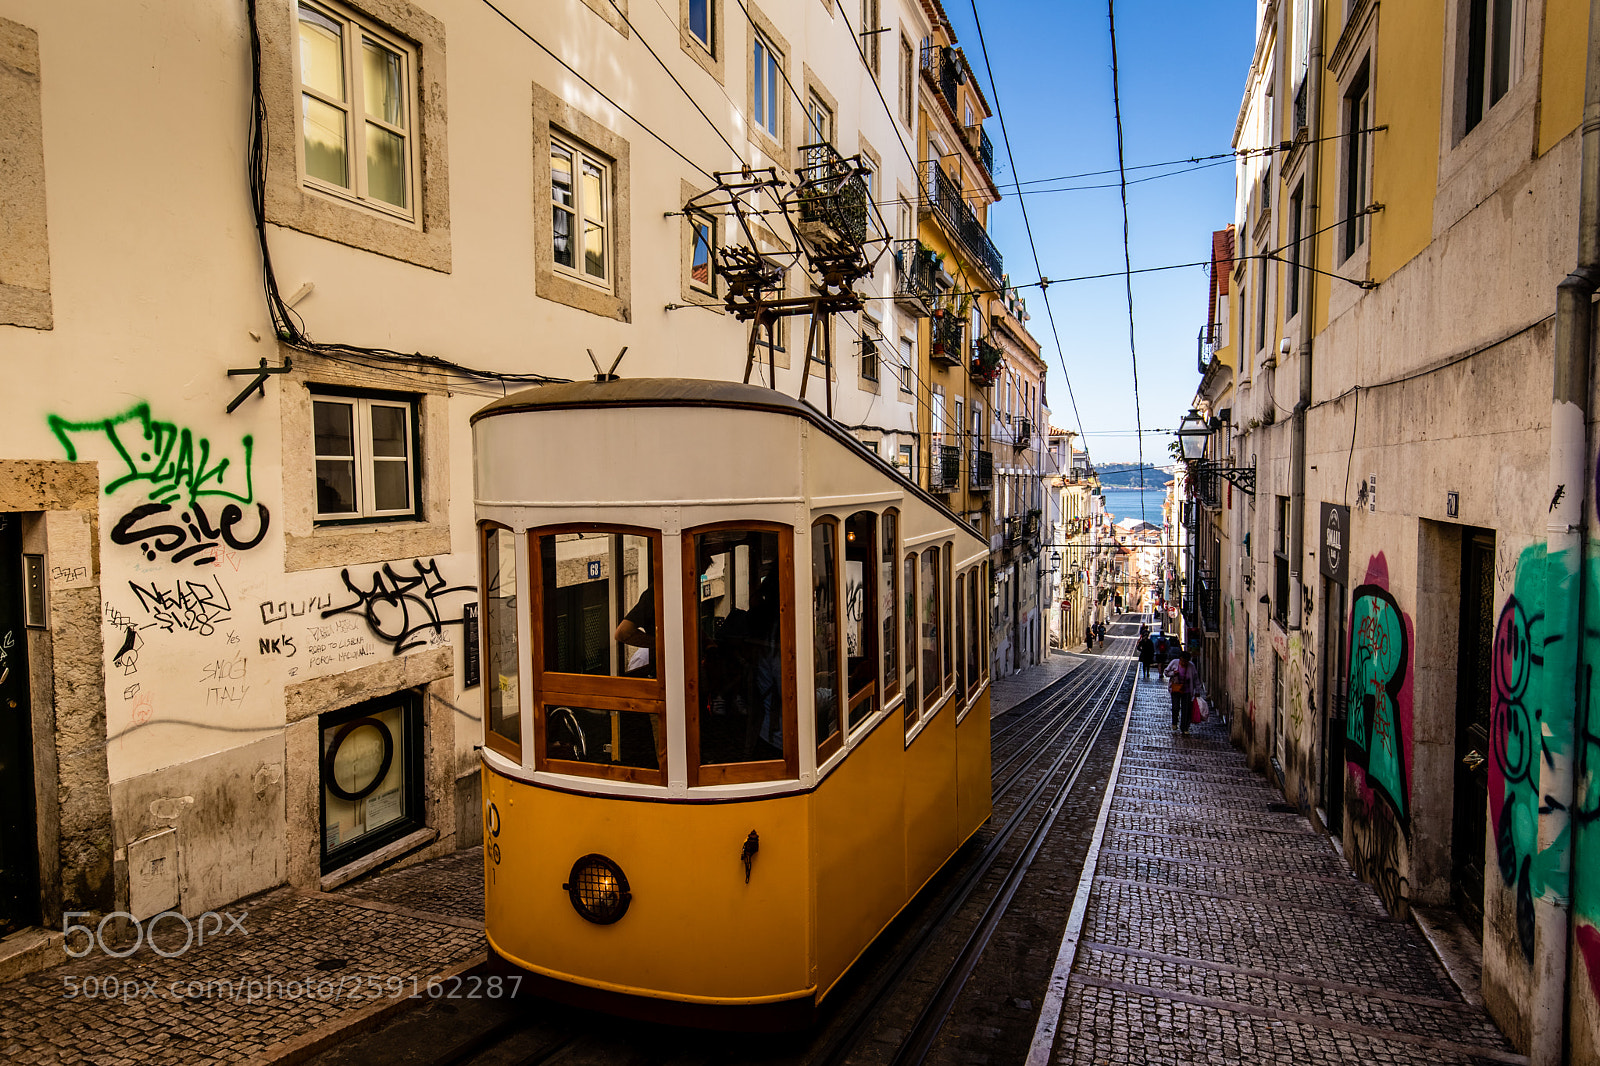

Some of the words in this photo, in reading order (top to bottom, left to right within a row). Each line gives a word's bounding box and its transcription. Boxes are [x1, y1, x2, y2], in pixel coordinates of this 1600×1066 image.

[590, 563, 599, 576] 68
[128, 573, 232, 613] NEVER
[206, 685, 250, 708] ITALY
